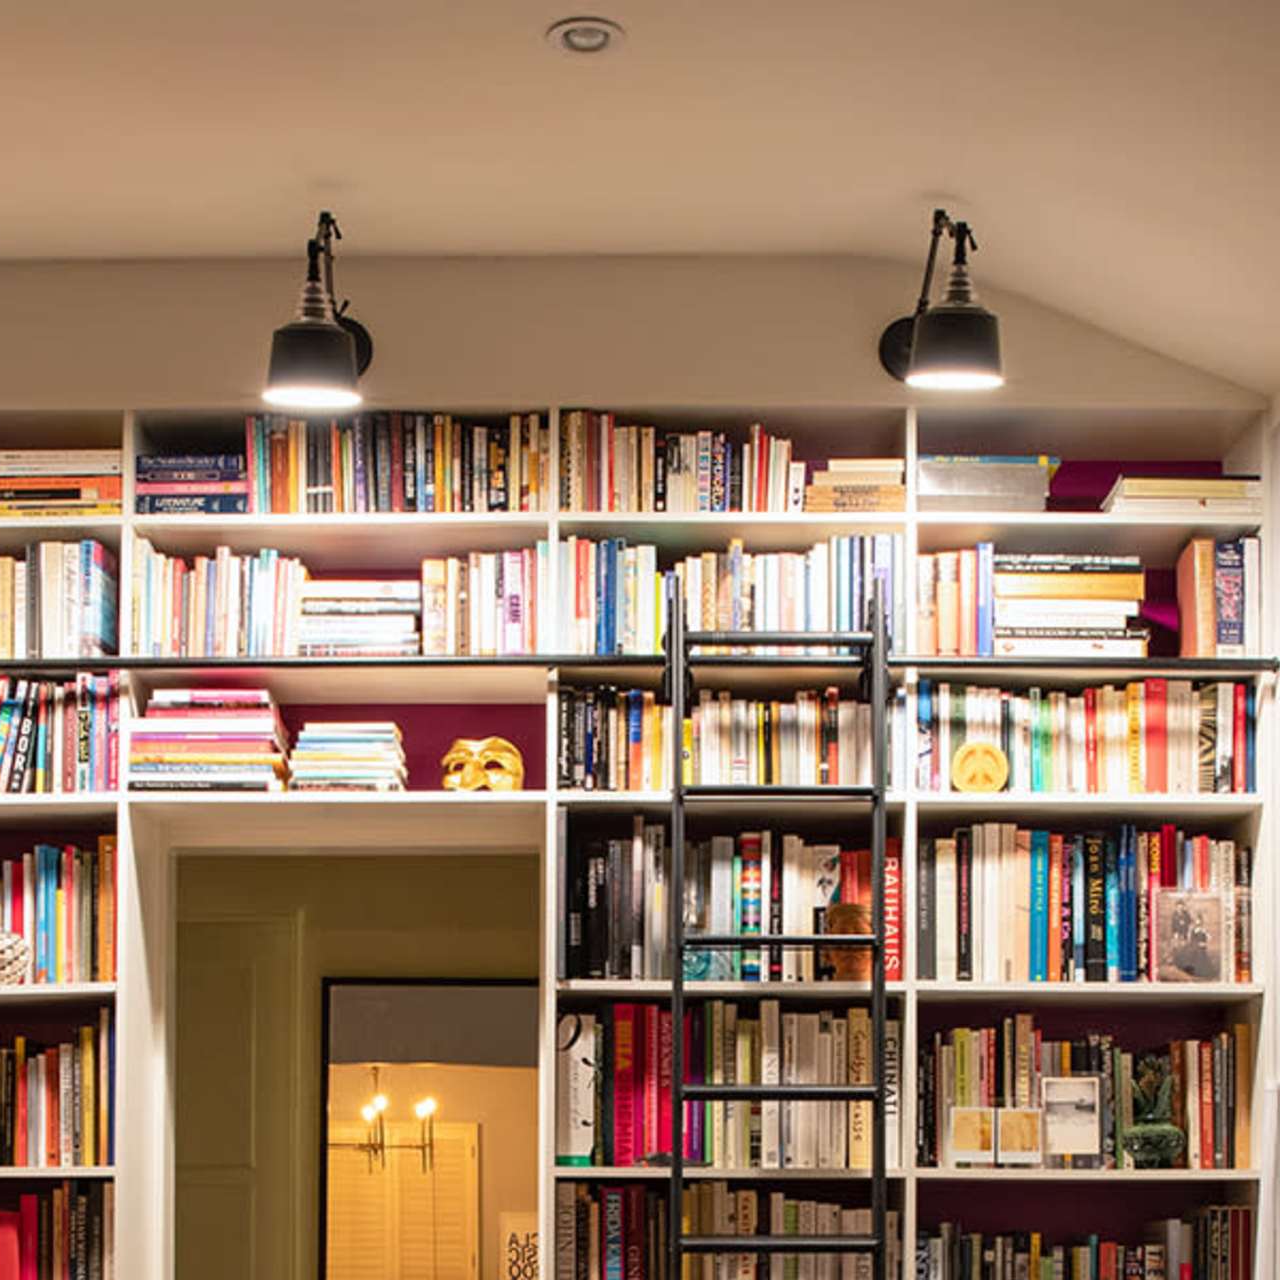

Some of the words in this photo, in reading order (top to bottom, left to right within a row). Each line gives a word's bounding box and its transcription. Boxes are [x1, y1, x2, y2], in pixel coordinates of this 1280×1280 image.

[884, 857, 899, 971] BAUHAUS
[1089, 877, 1103, 915] Miró
[559, 1205, 572, 1252] JOHN
[607, 1194, 621, 1238] FRIDA
[742, 1196, 751, 1232] VANIT
